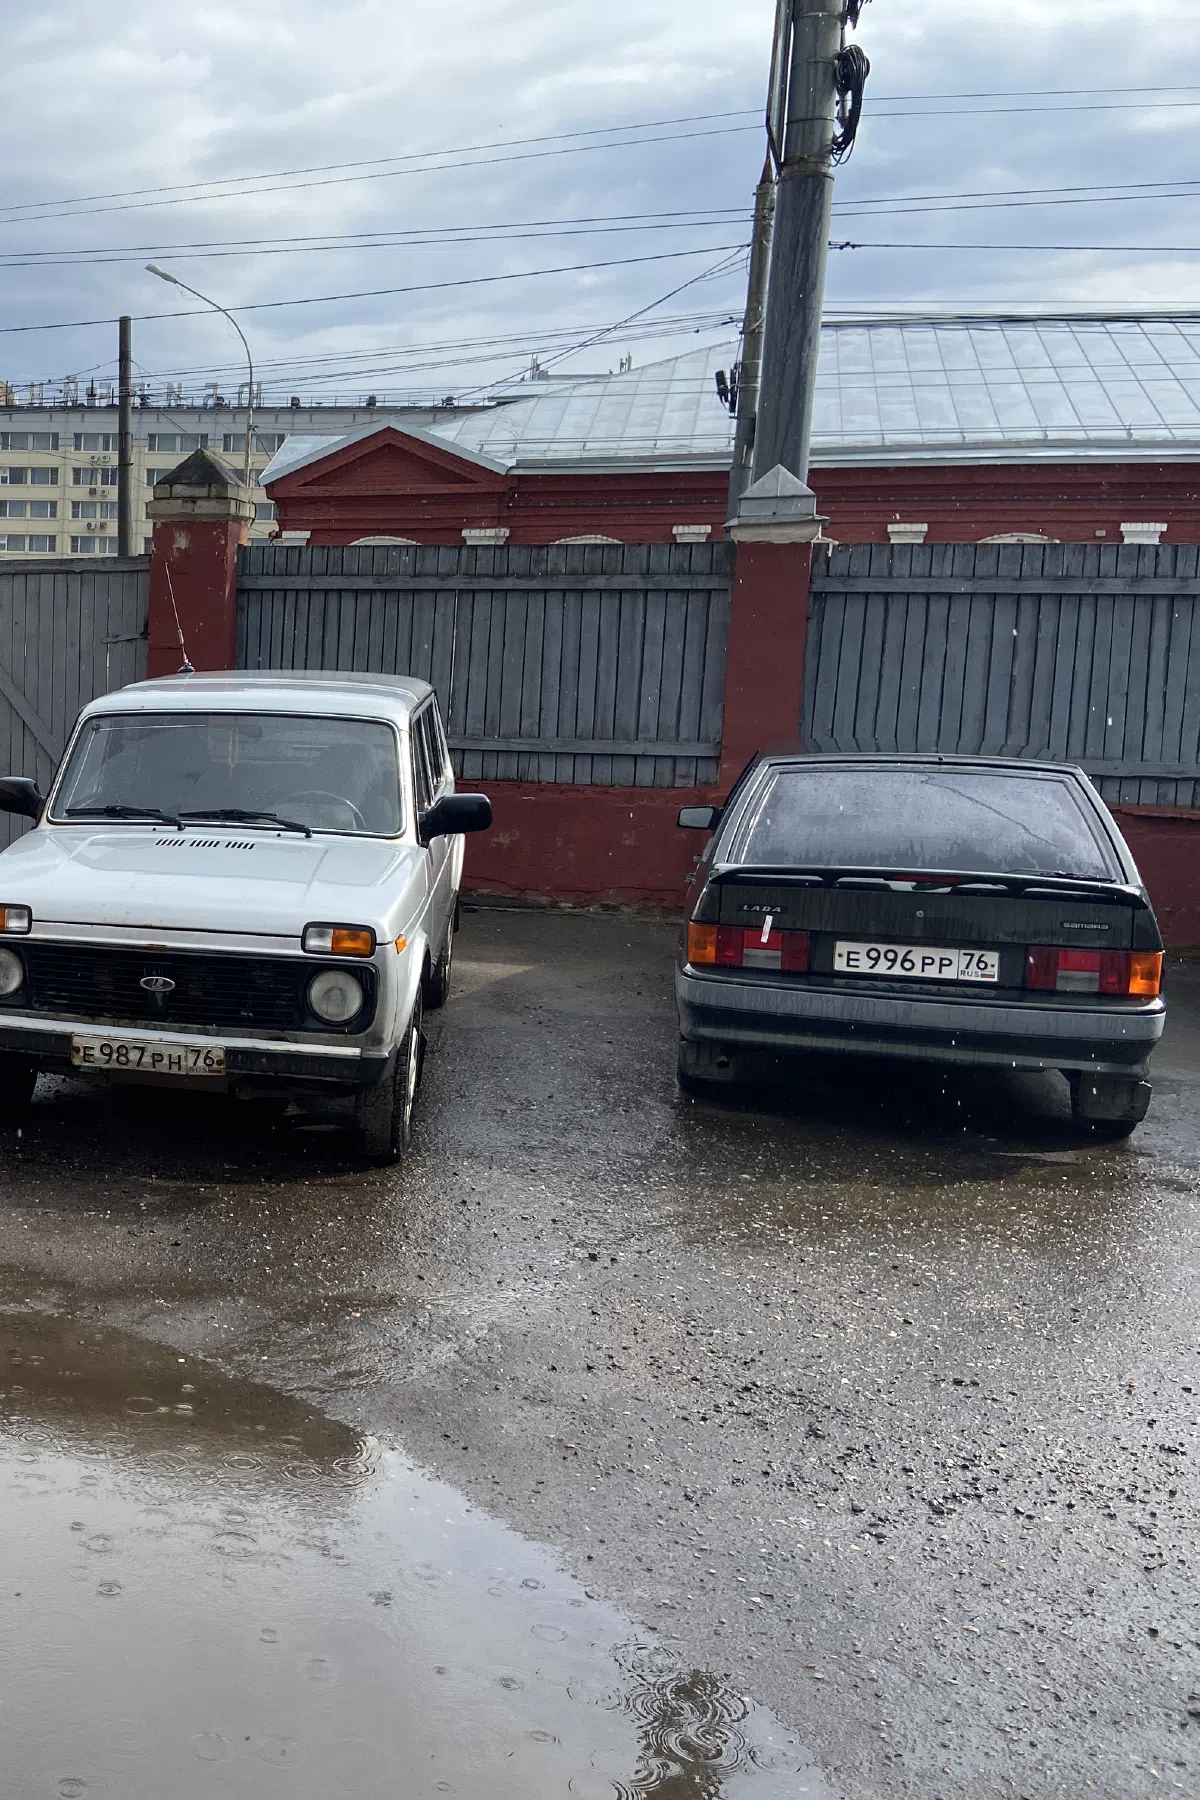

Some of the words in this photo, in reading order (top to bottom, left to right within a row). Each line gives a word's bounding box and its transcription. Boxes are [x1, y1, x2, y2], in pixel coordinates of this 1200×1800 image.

[743, 904, 781, 913] LADA
[962, 952, 988, 971] 76
[960, 969, 980, 978] RUS
[190, 1048, 216, 1067] 76
[189, 1066, 209, 1074] RUS
